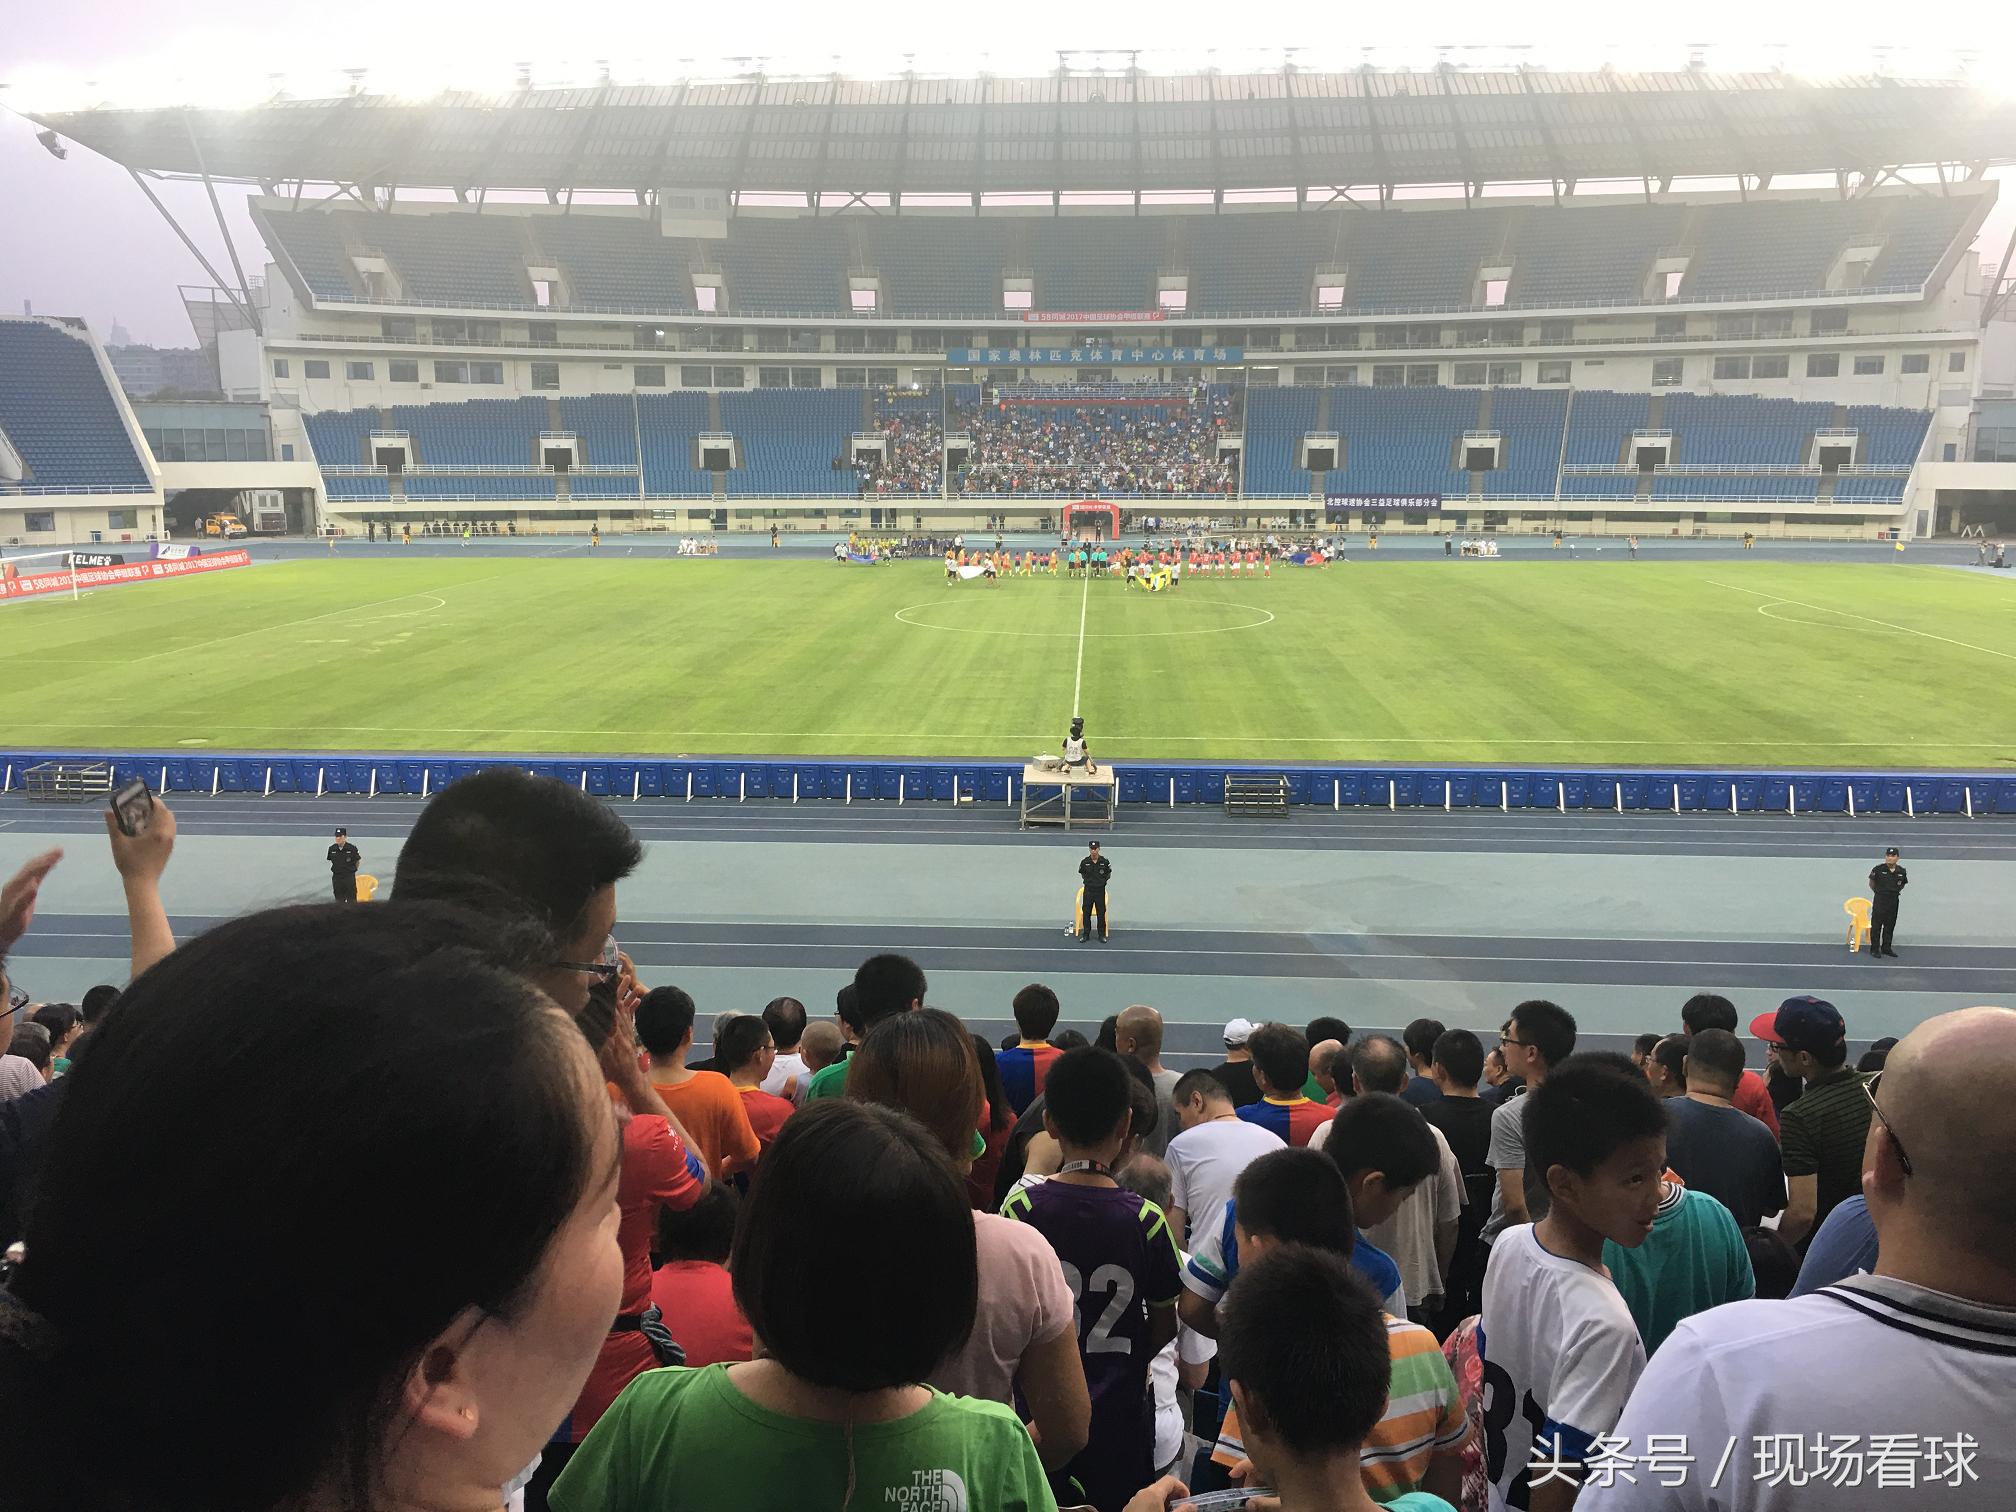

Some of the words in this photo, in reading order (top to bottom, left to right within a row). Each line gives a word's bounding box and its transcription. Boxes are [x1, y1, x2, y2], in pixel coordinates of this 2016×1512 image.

[967, 349, 1227, 362] 国家奥林匹克体育中心体育场
[67, 554, 104, 565] KELME
[911, 1469, 943, 1486] THE
[884, 1485, 943, 1502] NORTH
[900, 1501, 942, 1512] FACE
